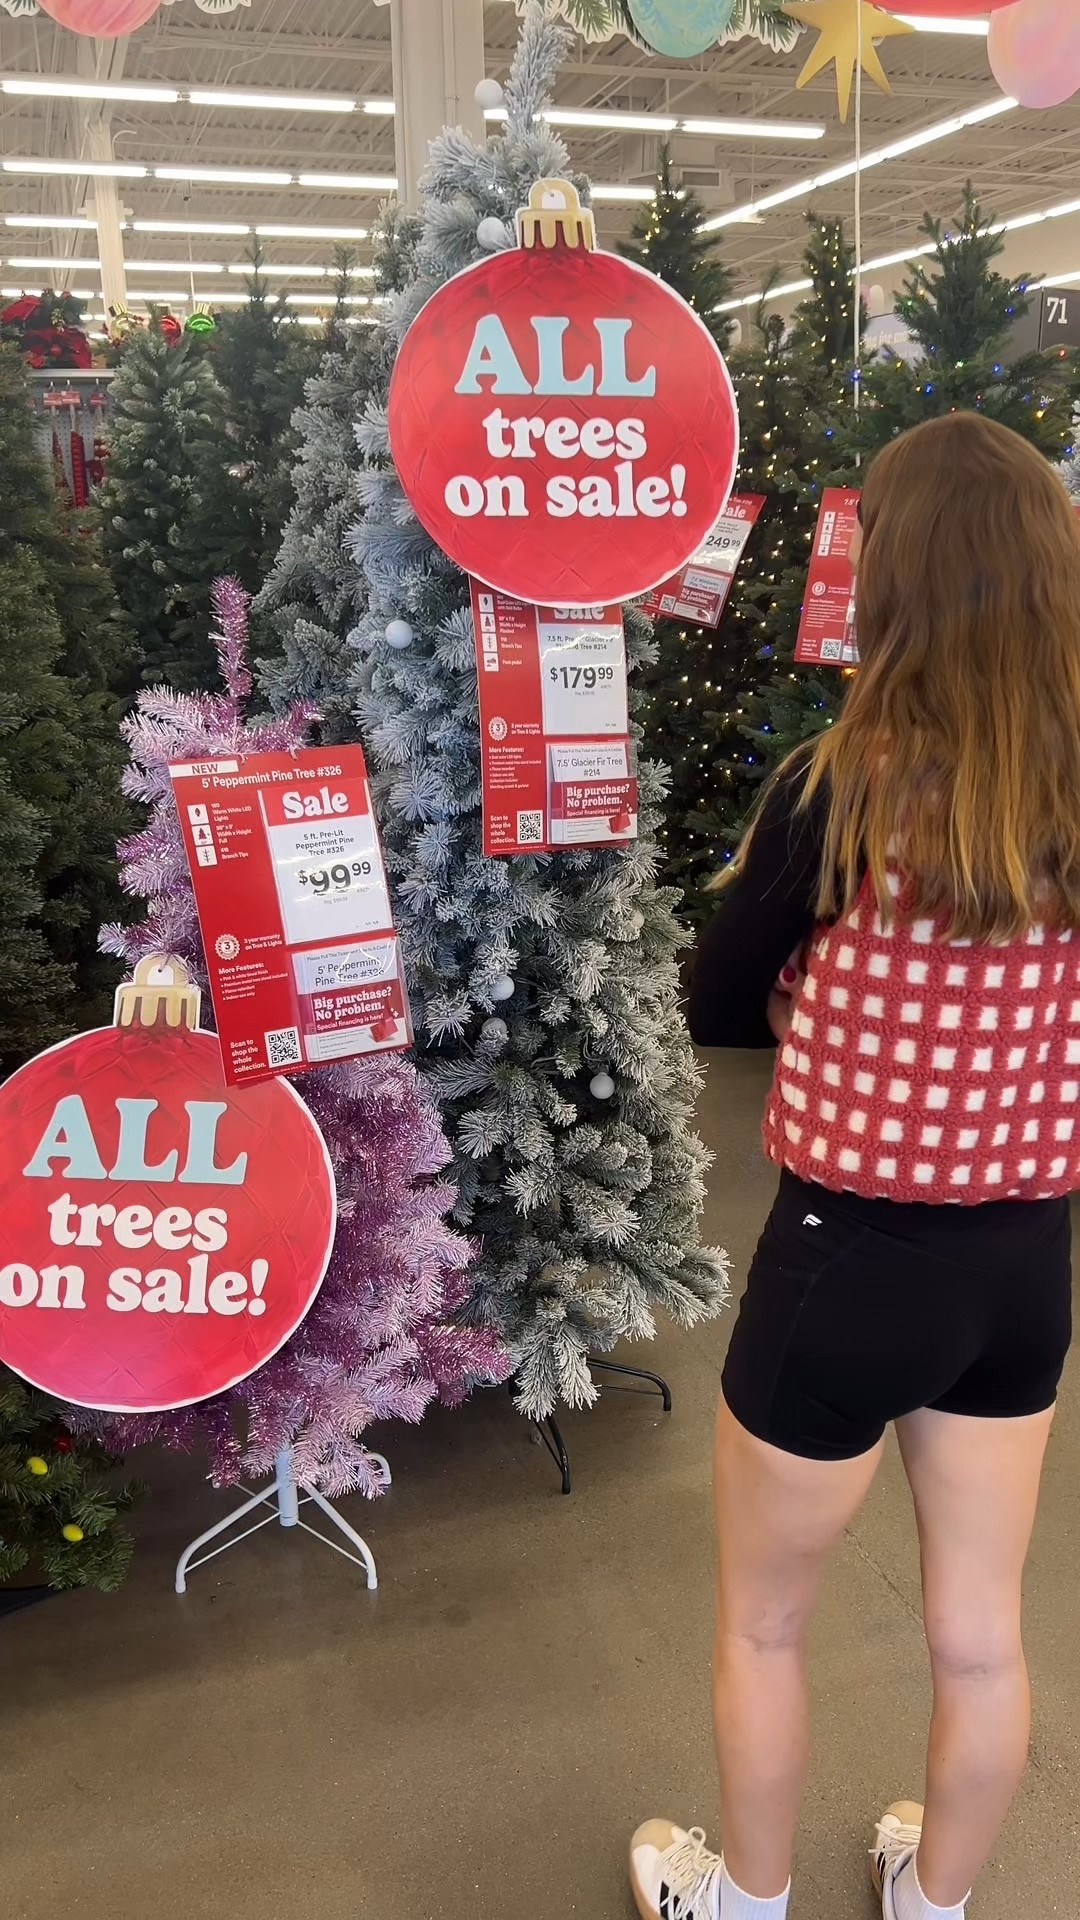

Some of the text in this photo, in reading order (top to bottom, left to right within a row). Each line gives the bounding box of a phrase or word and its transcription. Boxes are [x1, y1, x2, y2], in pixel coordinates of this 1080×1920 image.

[1046, 296, 1068, 325] 71
[454, 313, 656, 397] ALL
[482, 408, 648, 460] trees
[444, 460, 688, 518] on sale!
[725, 504, 747, 518] ale
[192, 764, 218, 775] NEW
[556, 757, 623, 768] 7.5' Glacier Fir Tree
[201, 766, 342, 788] 5' Peppermint Pine Tree #326
[583, 769, 600, 777] #214
[566, 784, 630, 798] Big purchase?
[282, 786, 349, 819] Sale
[567, 796, 623, 809] No problem.
[303, 829, 344, 841] 5 ft. Pre-Lit
[295, 836, 355, 850] Peppermint Pine
[327, 846, 345, 855] #326
[224, 942, 231, 950] 3
[218, 963, 264, 975] More Features:
[318, 966, 326, 974] 5'
[315, 976, 335, 986] Pine
[338, 972, 358, 982] Tree
[314, 986, 392, 1010] Big purchase?
[315, 1002, 385, 1021] No problem.
[317, 1022, 338, 1031] Special
[339, 1016, 364, 1026] financing
[230, 1040, 246, 1049] Scan
[232, 1049, 247, 1057] shop
[233, 1056, 252, 1065] whole
[234, 1062, 266, 1073] collection.
[22, 1094, 248, 1185] ALL
[47, 1192, 228, 1252] trees
[0, 1253, 269, 1316] on sale!
